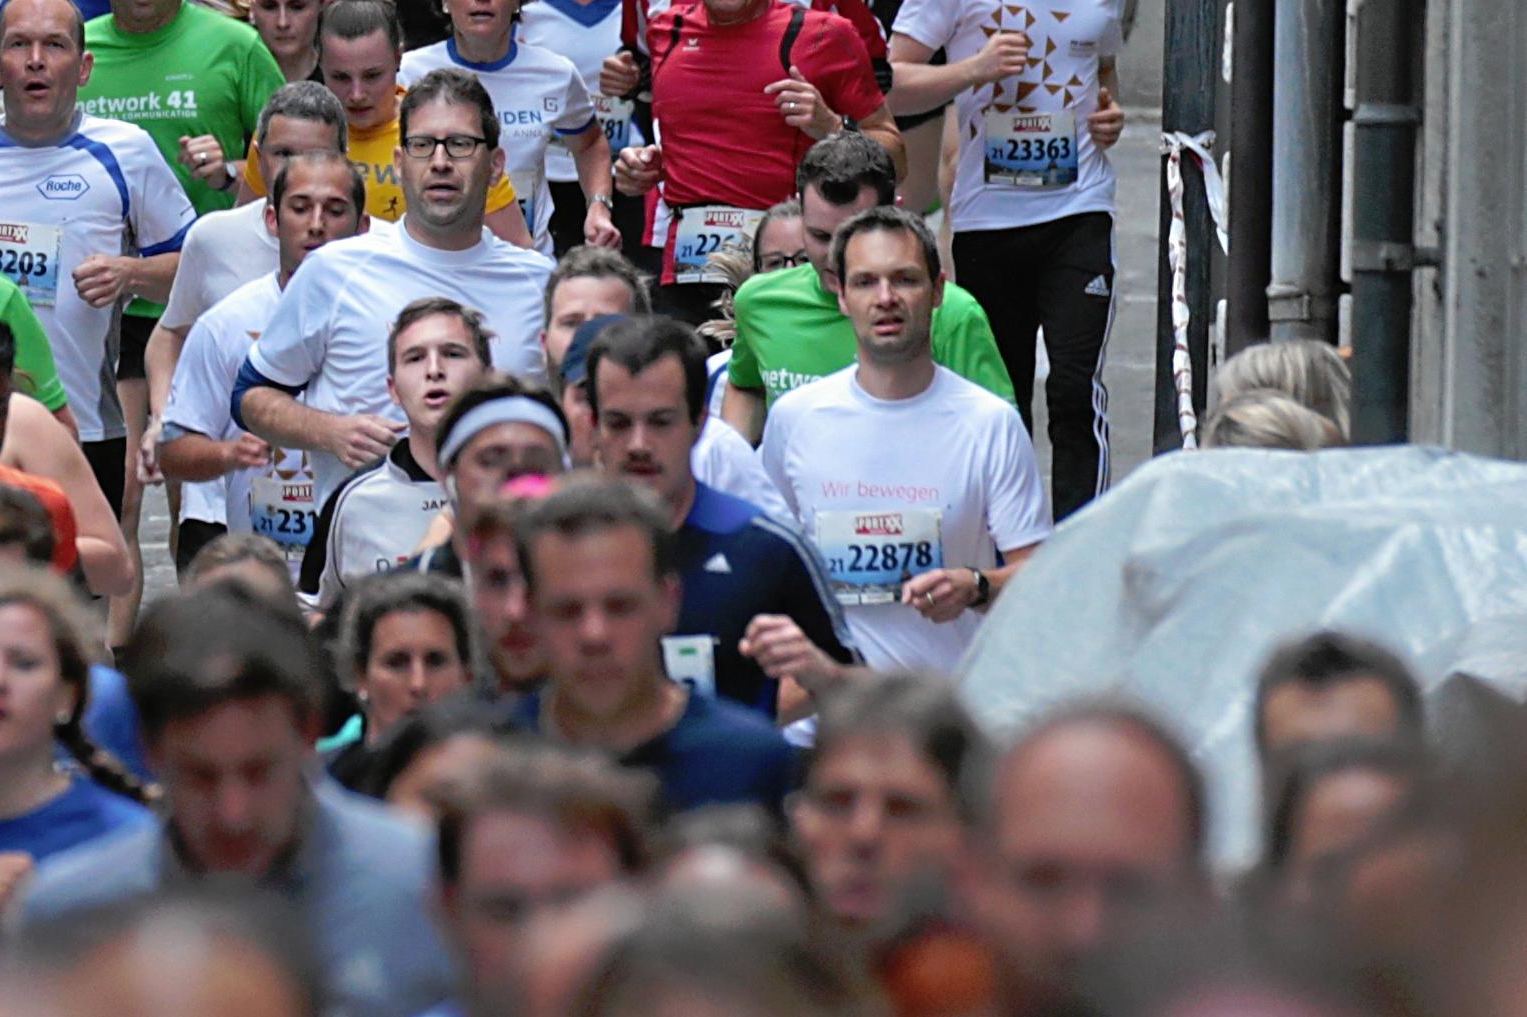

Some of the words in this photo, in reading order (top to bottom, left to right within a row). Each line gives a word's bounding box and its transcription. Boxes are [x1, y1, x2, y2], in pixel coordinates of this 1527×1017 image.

[167, 89, 197, 109] 41
[1006, 137, 1071, 161] 23363
[46, 180, 83, 192] Roche
[822, 481, 849, 498] Wir
[857, 480, 939, 504] bewegen
[261, 517, 273, 532] 21
[829, 559, 843, 573] 21
[848, 541, 932, 572] 22878
